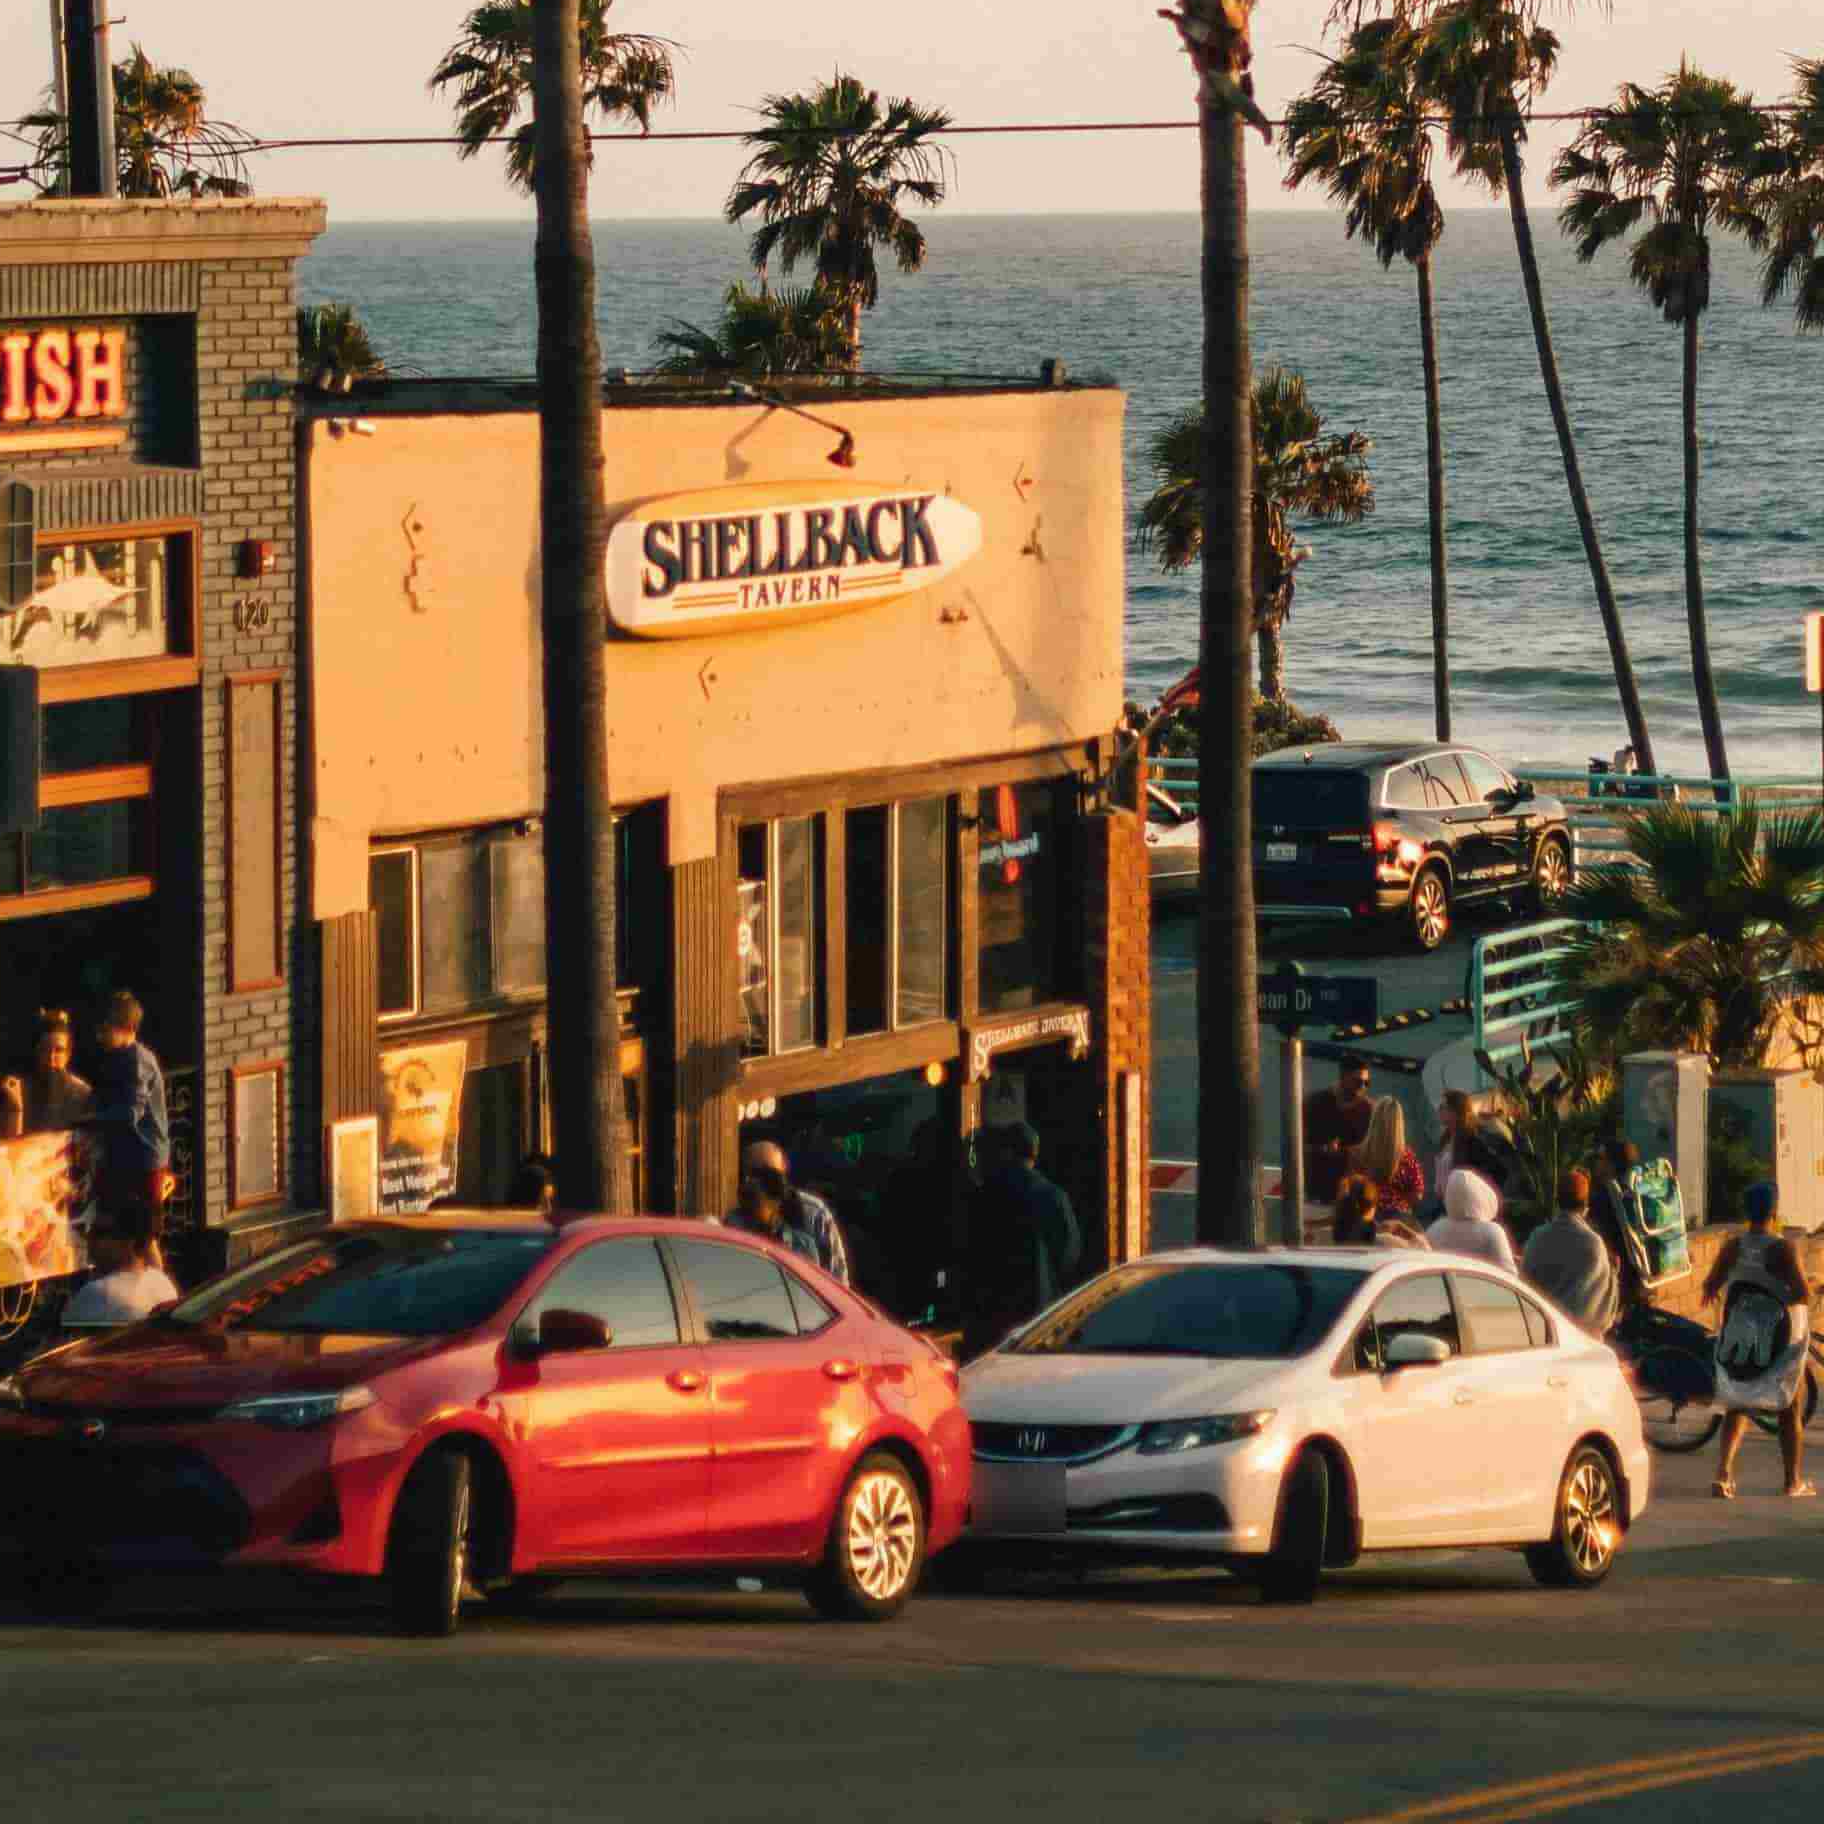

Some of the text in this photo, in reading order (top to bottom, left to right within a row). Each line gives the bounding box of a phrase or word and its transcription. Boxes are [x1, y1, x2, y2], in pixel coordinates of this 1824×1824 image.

[640, 493, 943, 599] SHELLBACK
[739, 573, 842, 609] TAVERN
[239, 597, 272, 633] 120
